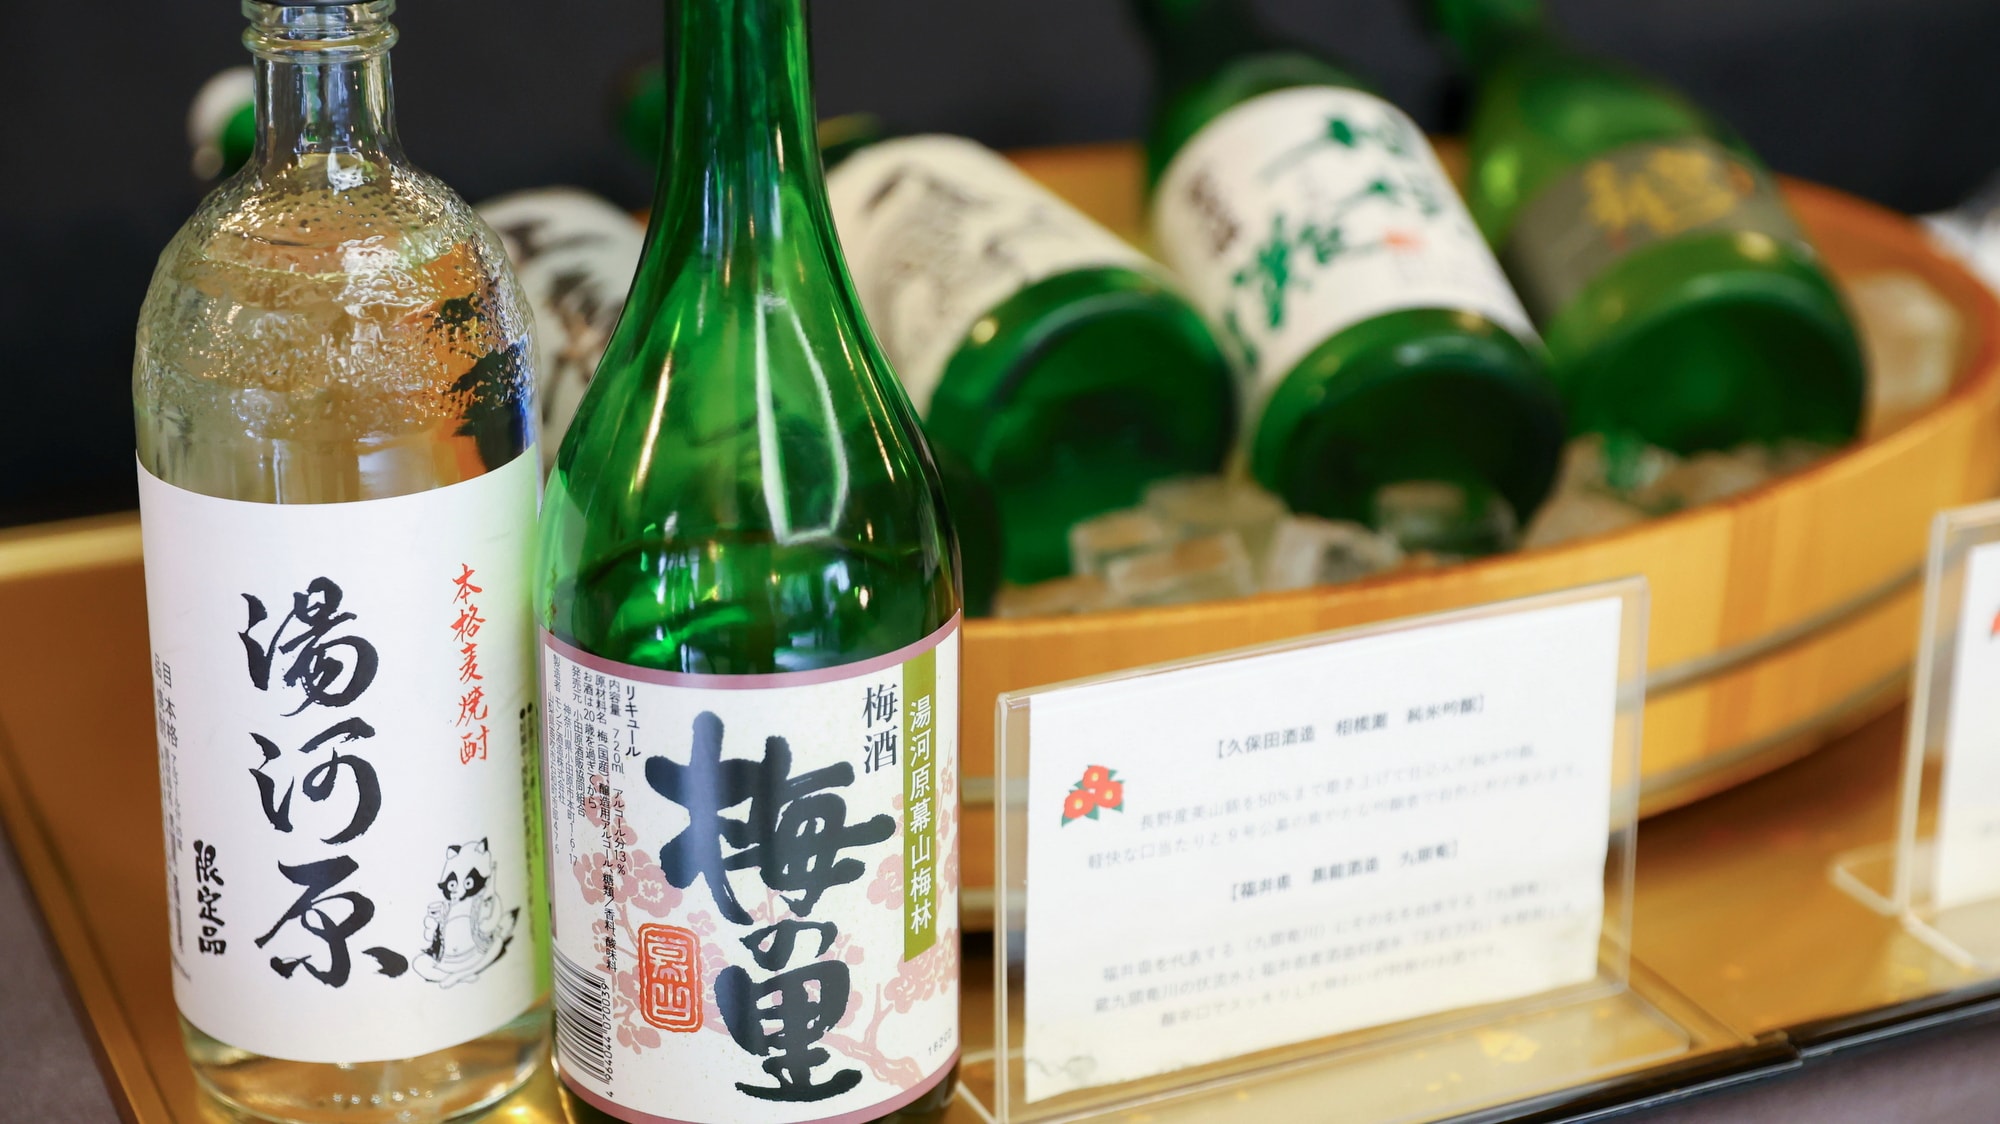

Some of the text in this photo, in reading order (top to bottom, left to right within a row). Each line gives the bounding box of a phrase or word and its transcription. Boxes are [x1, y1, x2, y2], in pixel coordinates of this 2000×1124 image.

[449, 563, 490, 765] 本格麦焼酎
[624, 684, 642, 758] リキュール
[861, 683, 898, 775] 梅酒
[237, 576, 409, 989] 湯河原
[909, 694, 933, 936] 湯河原幕山梅林
[193, 839, 227, 956] 限定品
[644, 710, 896, 1102] 梅の里
